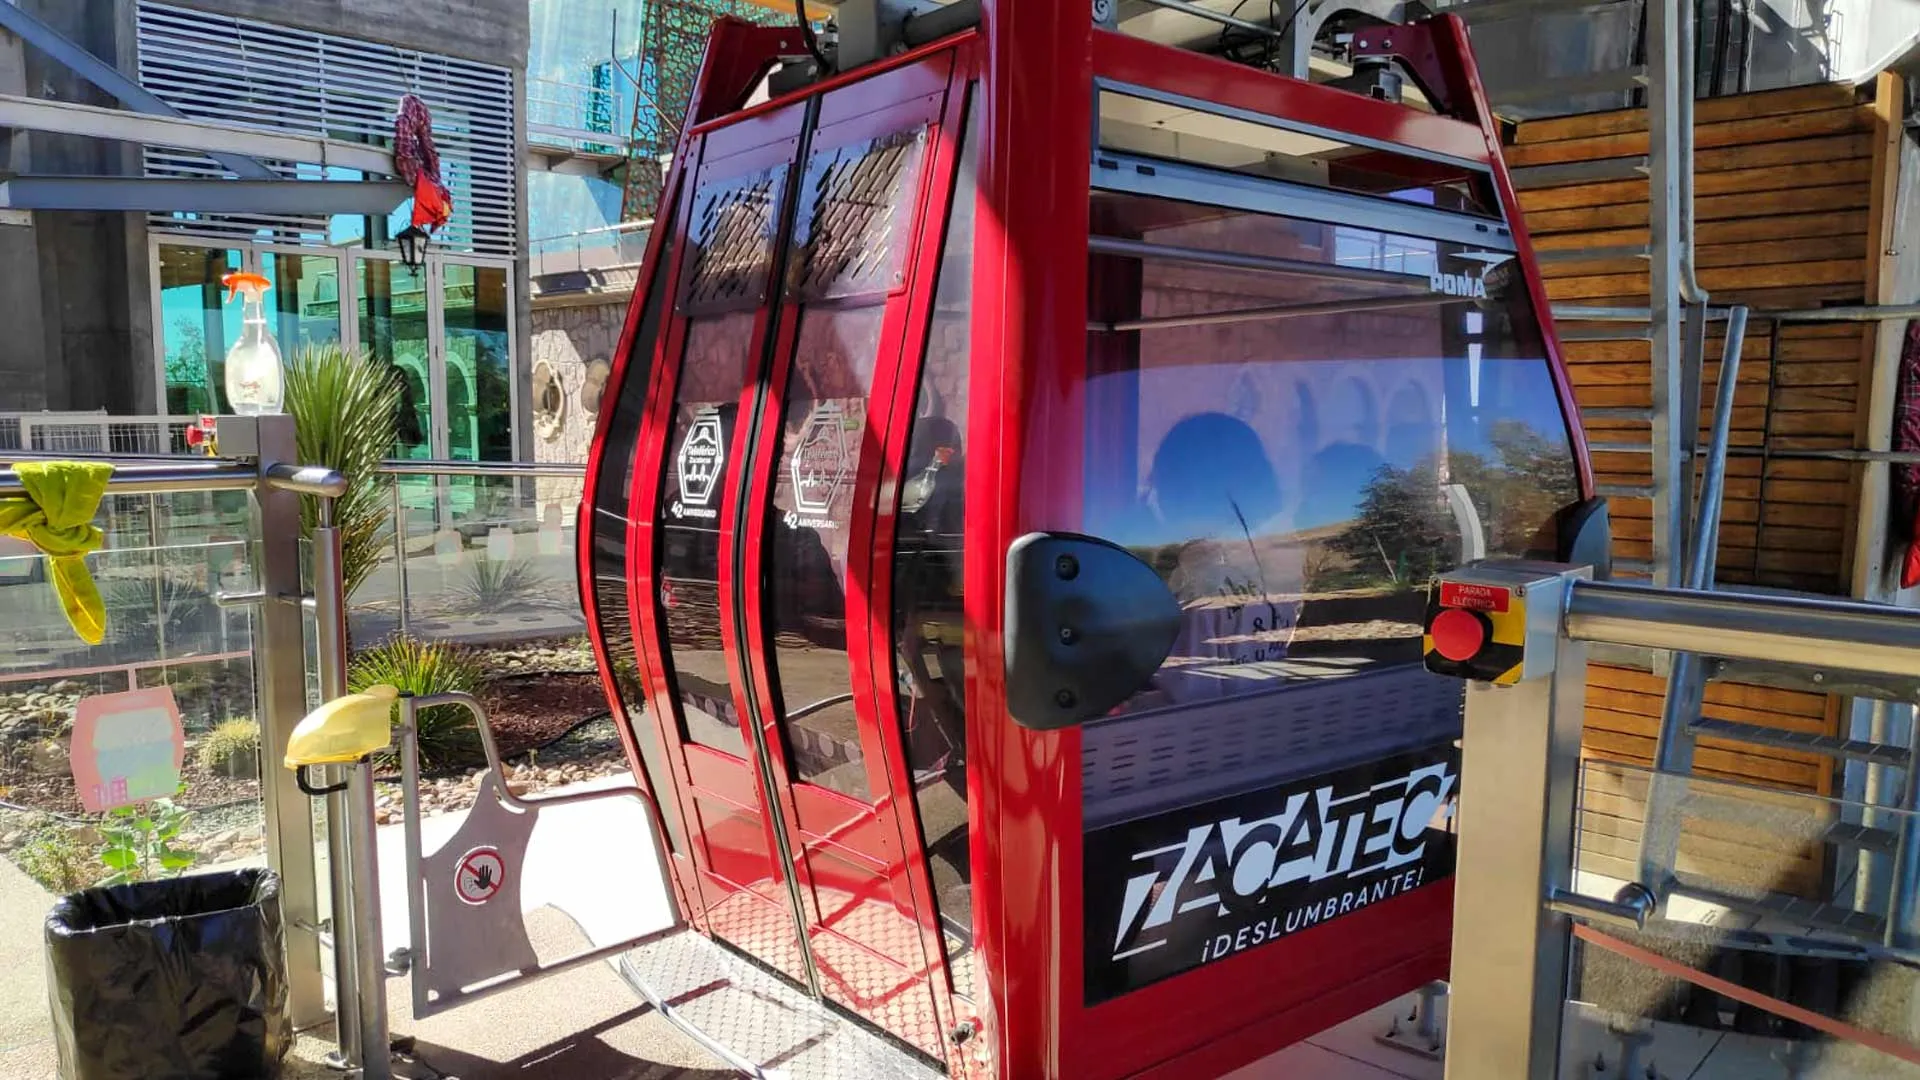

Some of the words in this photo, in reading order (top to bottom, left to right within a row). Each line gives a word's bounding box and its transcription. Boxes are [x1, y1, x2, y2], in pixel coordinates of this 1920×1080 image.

[1431, 272, 1487, 299] POMA
[671, 500, 684, 519] 42
[783, 510, 798, 530] 42
[1458, 585, 1492, 598] PARADA
[1112, 762, 1458, 961] ZACATEC
